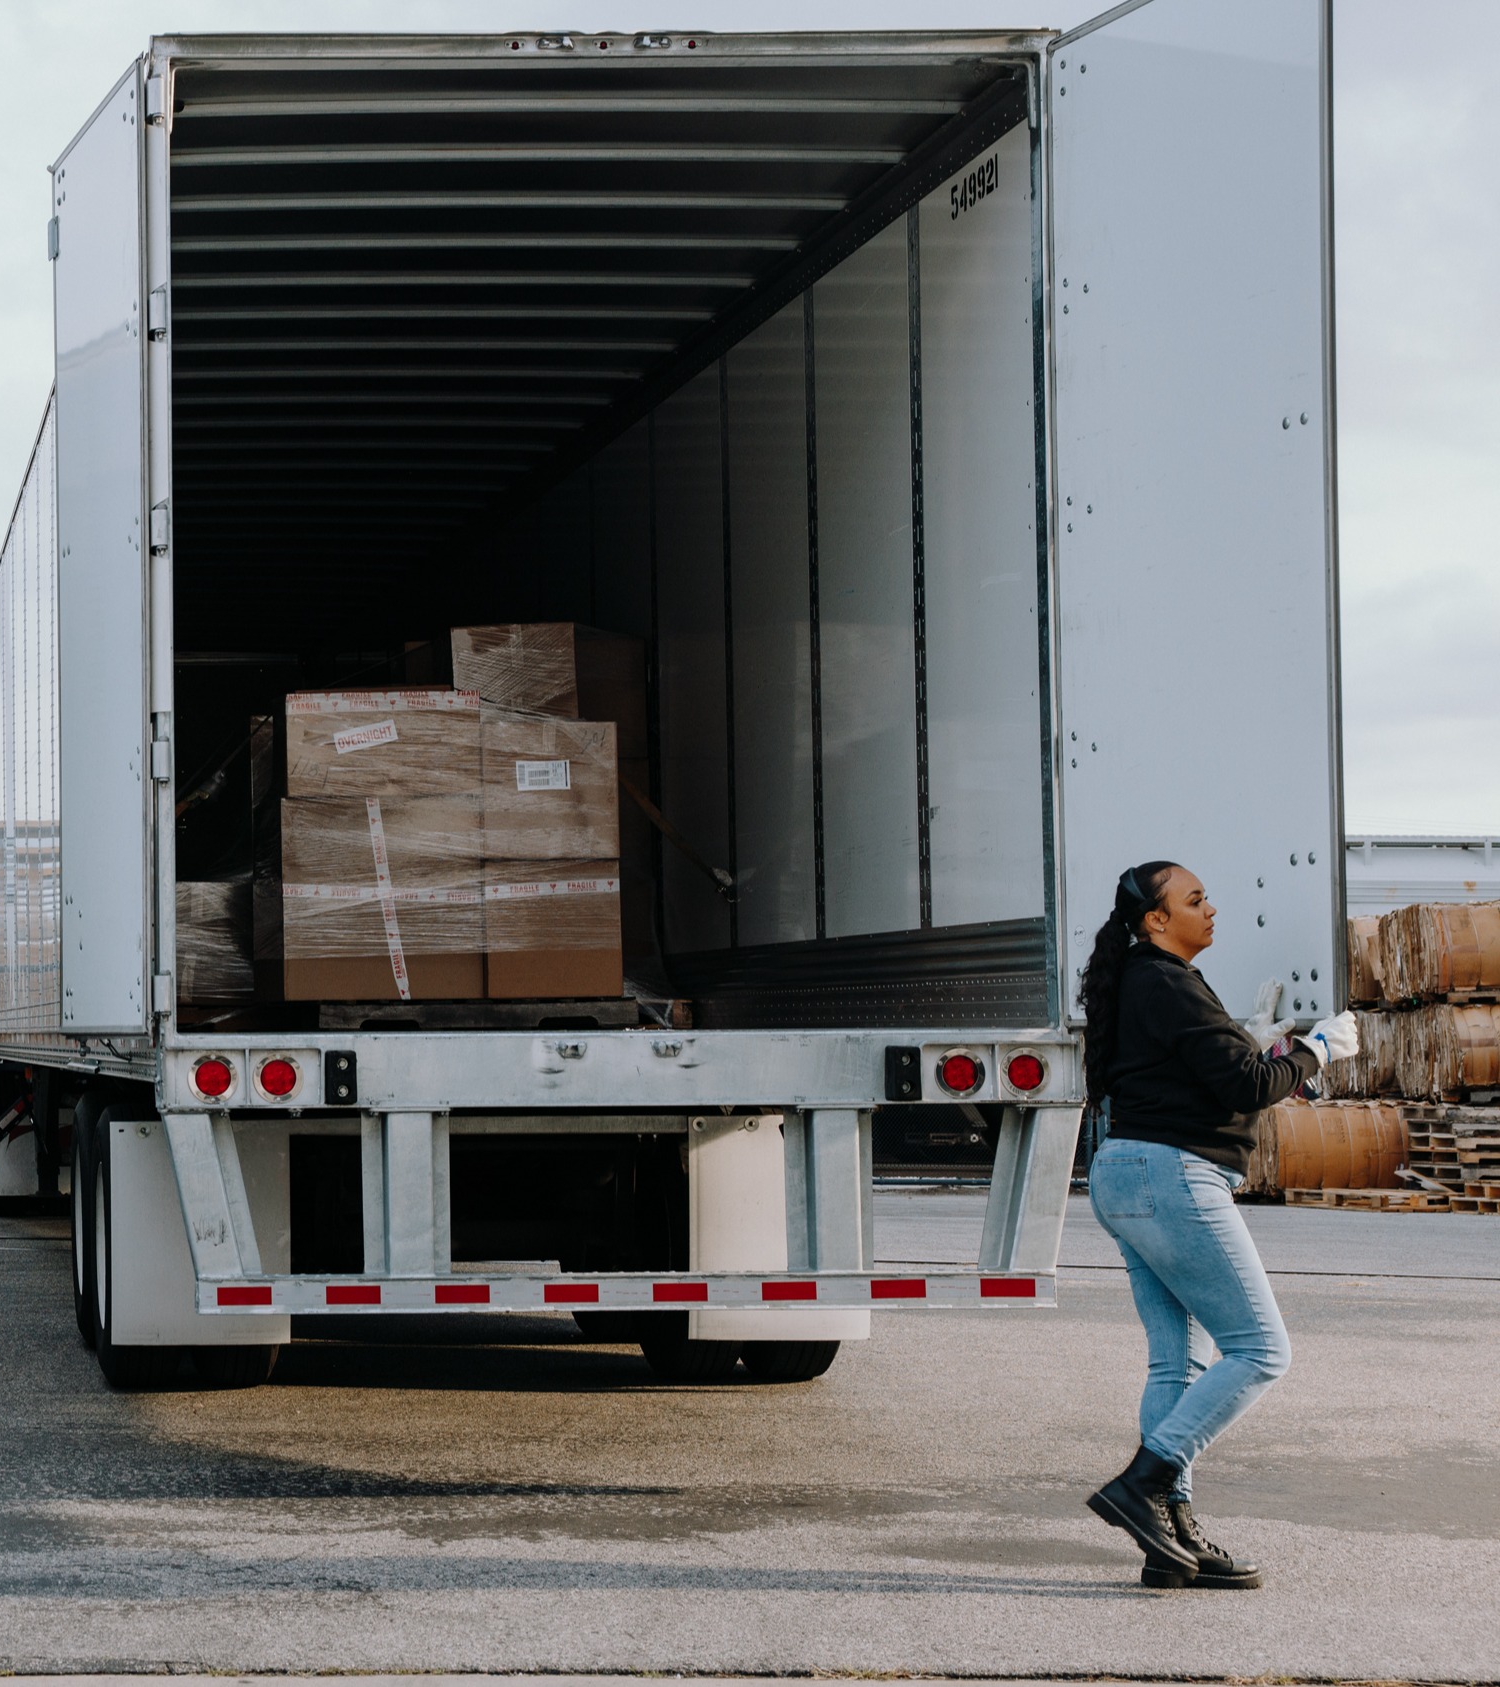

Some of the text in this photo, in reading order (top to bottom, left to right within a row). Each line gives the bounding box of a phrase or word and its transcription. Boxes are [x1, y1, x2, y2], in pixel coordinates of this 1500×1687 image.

[950, 152, 998, 220] 549921
[337, 725, 393, 749] OVERNIGHT
[510, 880, 597, 892] FRAGILE FRAGILE
[391, 948, 404, 980] FRAGILE
